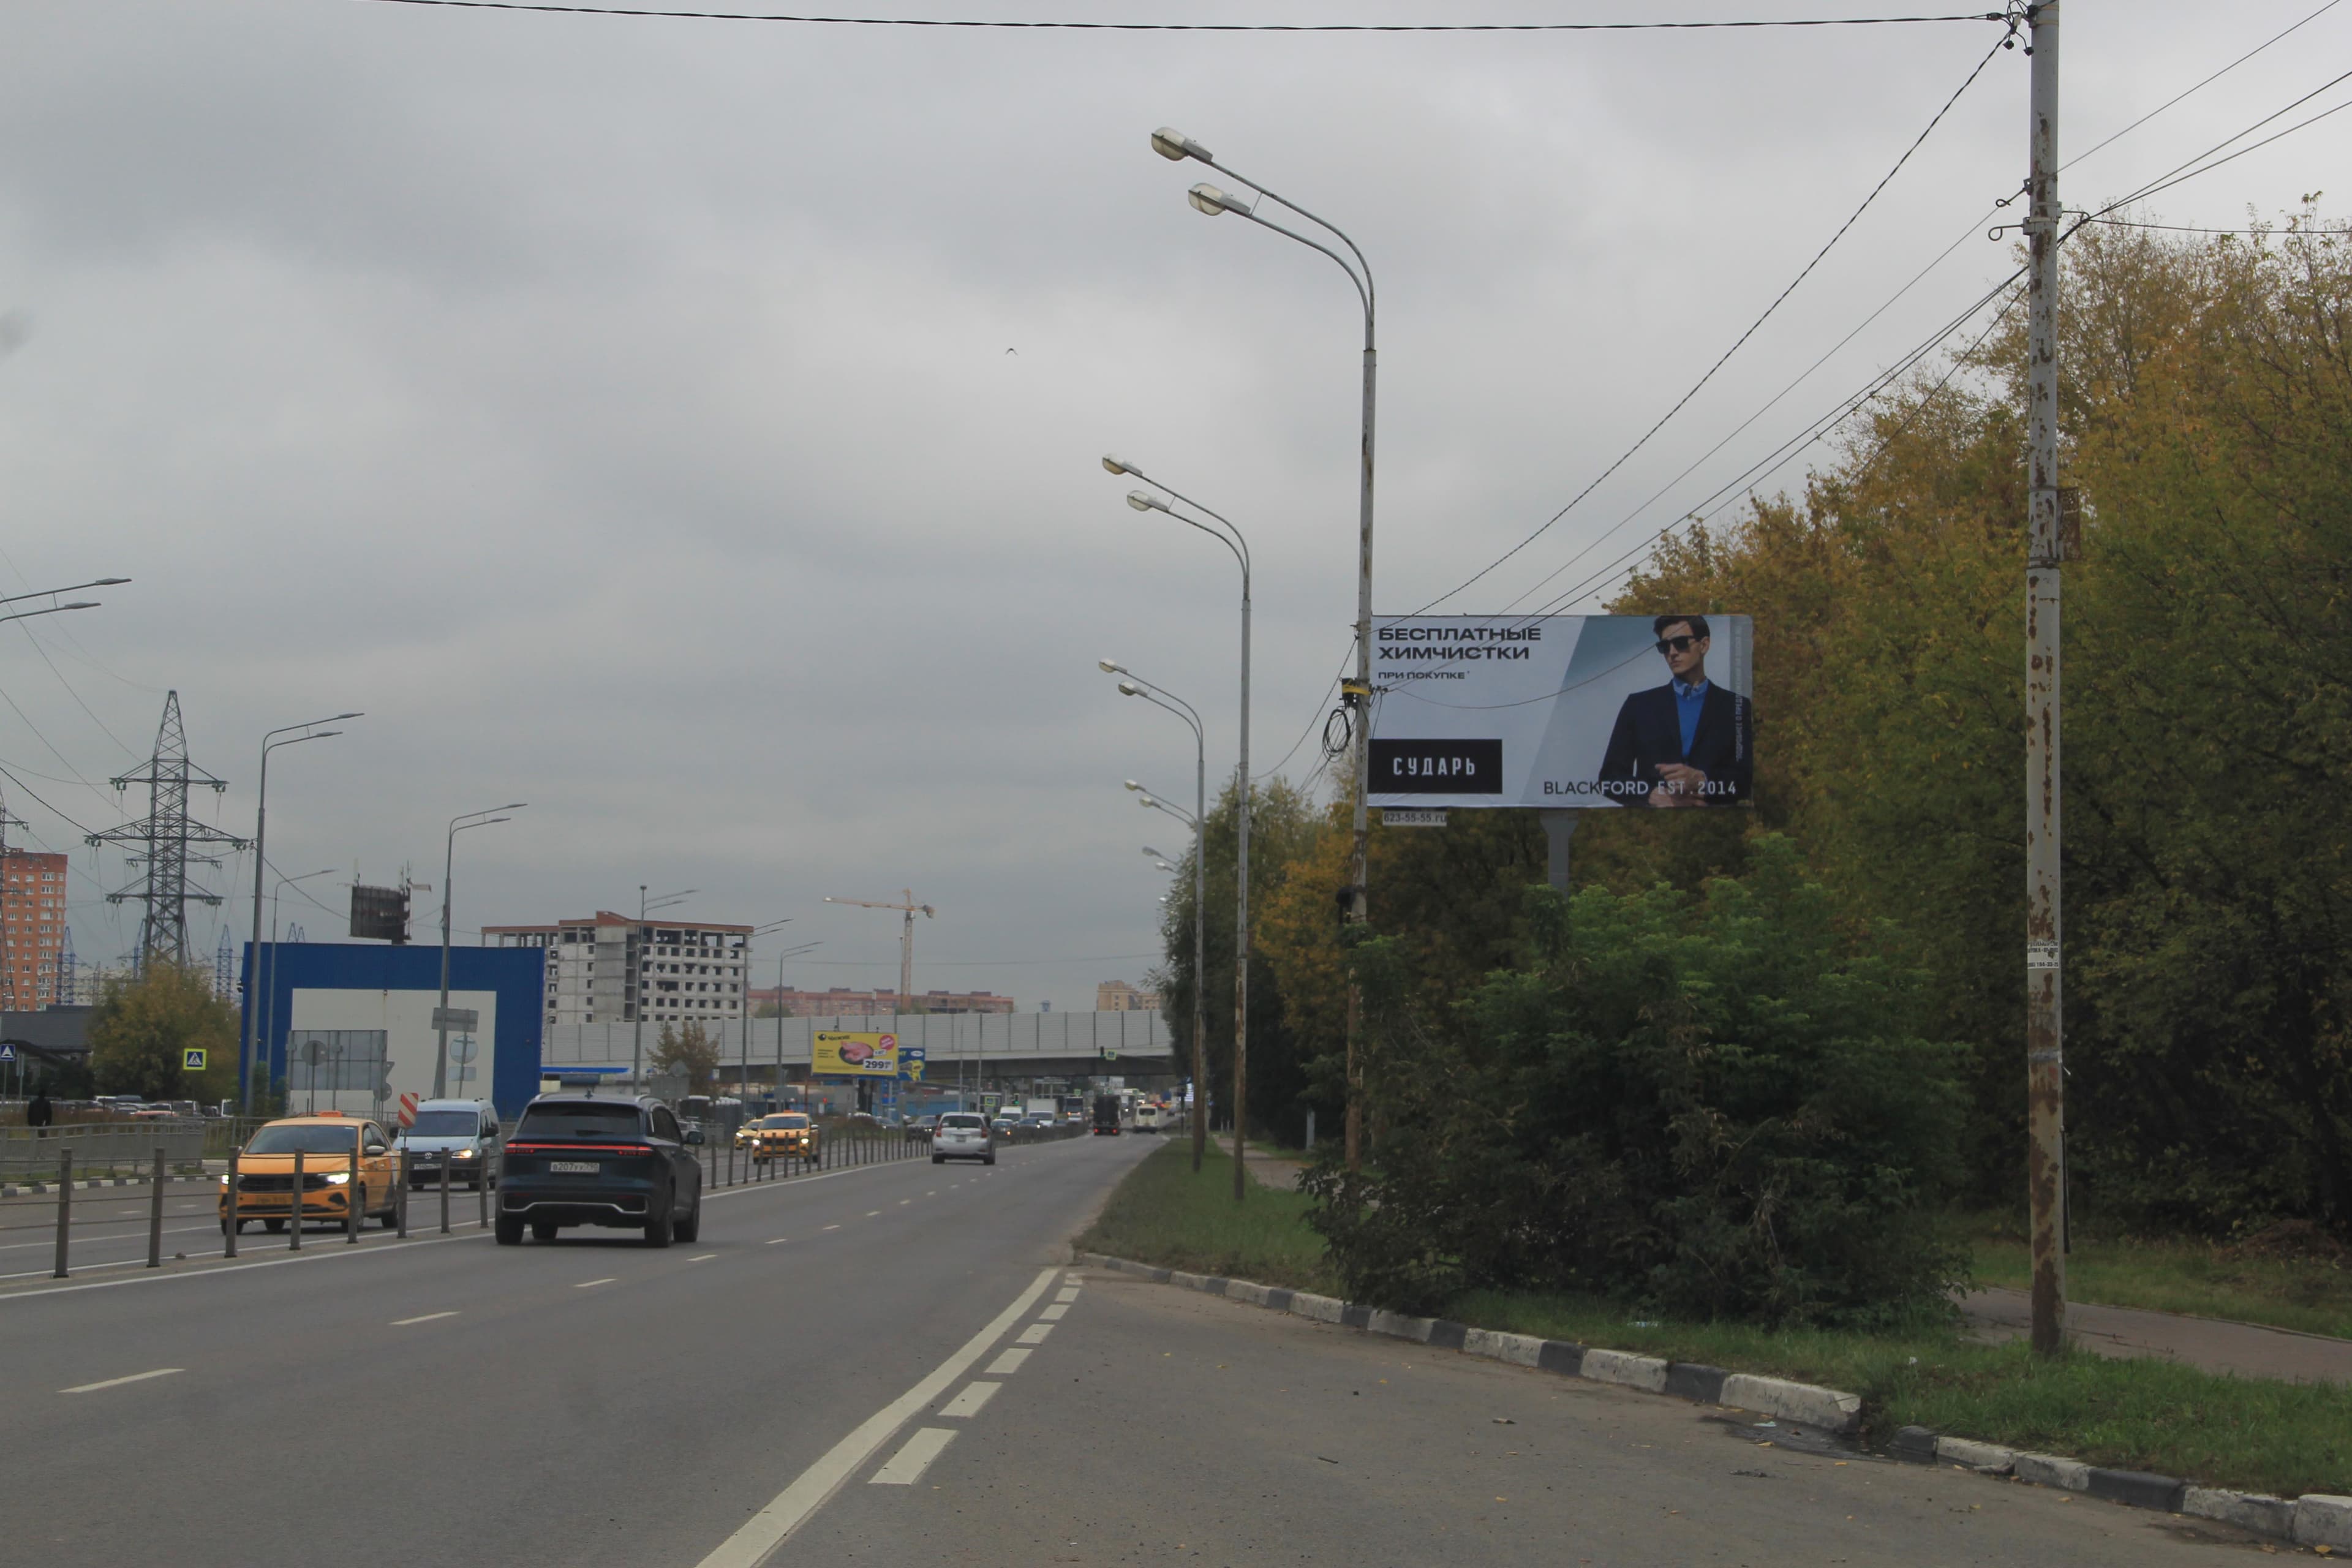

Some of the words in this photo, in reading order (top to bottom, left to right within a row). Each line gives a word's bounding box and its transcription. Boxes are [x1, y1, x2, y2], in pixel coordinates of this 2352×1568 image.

[1378, 628, 1541, 641] БЕСПЛАТНЫЕ
[1378, 647, 1529, 660] ХИМЧИСТКИ
[1393, 756, 1476, 776] СУДАРЬ
[1544, 781, 1648, 794] BLACKFORD
[1384, 813, 1446, 823] 623-55-55.ru
